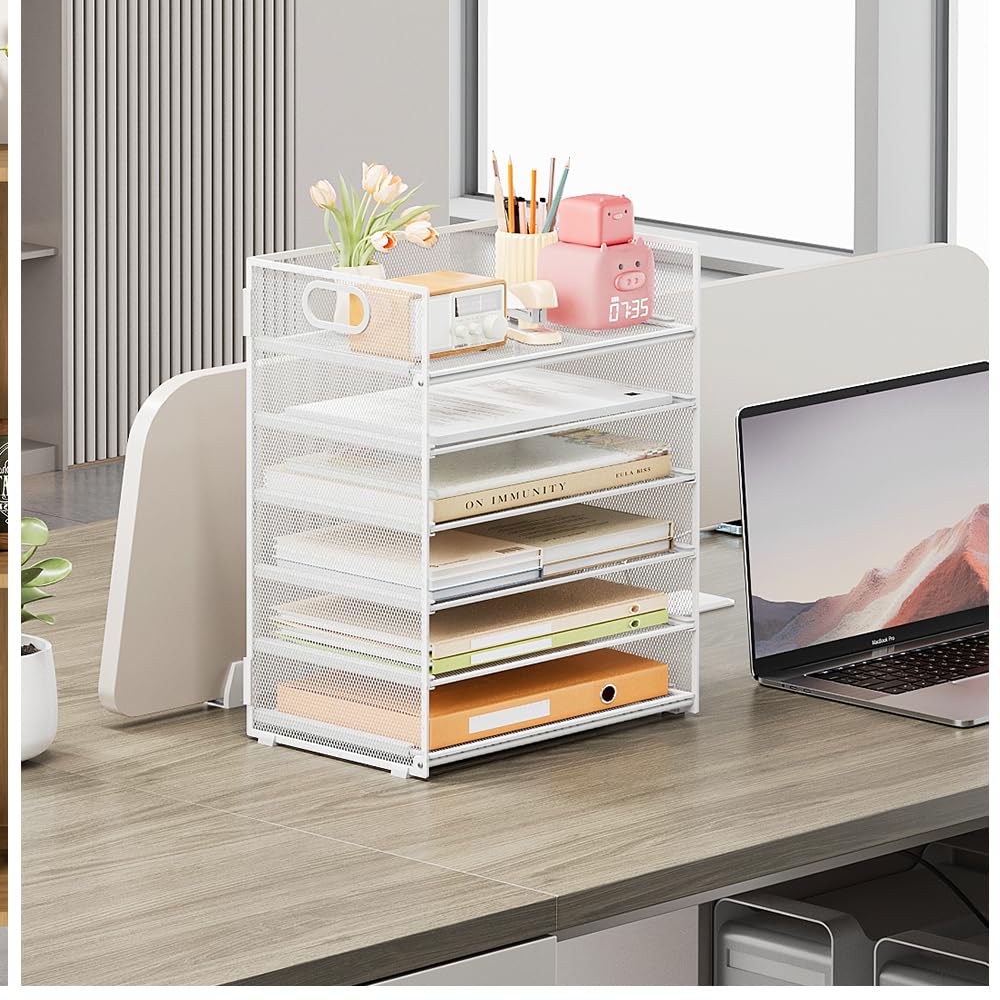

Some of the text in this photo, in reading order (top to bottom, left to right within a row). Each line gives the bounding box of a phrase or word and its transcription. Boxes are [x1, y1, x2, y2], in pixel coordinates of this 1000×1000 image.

[609, 298, 648, 322] 07:35
[616, 470, 634, 478] EULA
[465, 482, 568, 510] ON IMMUNITY
